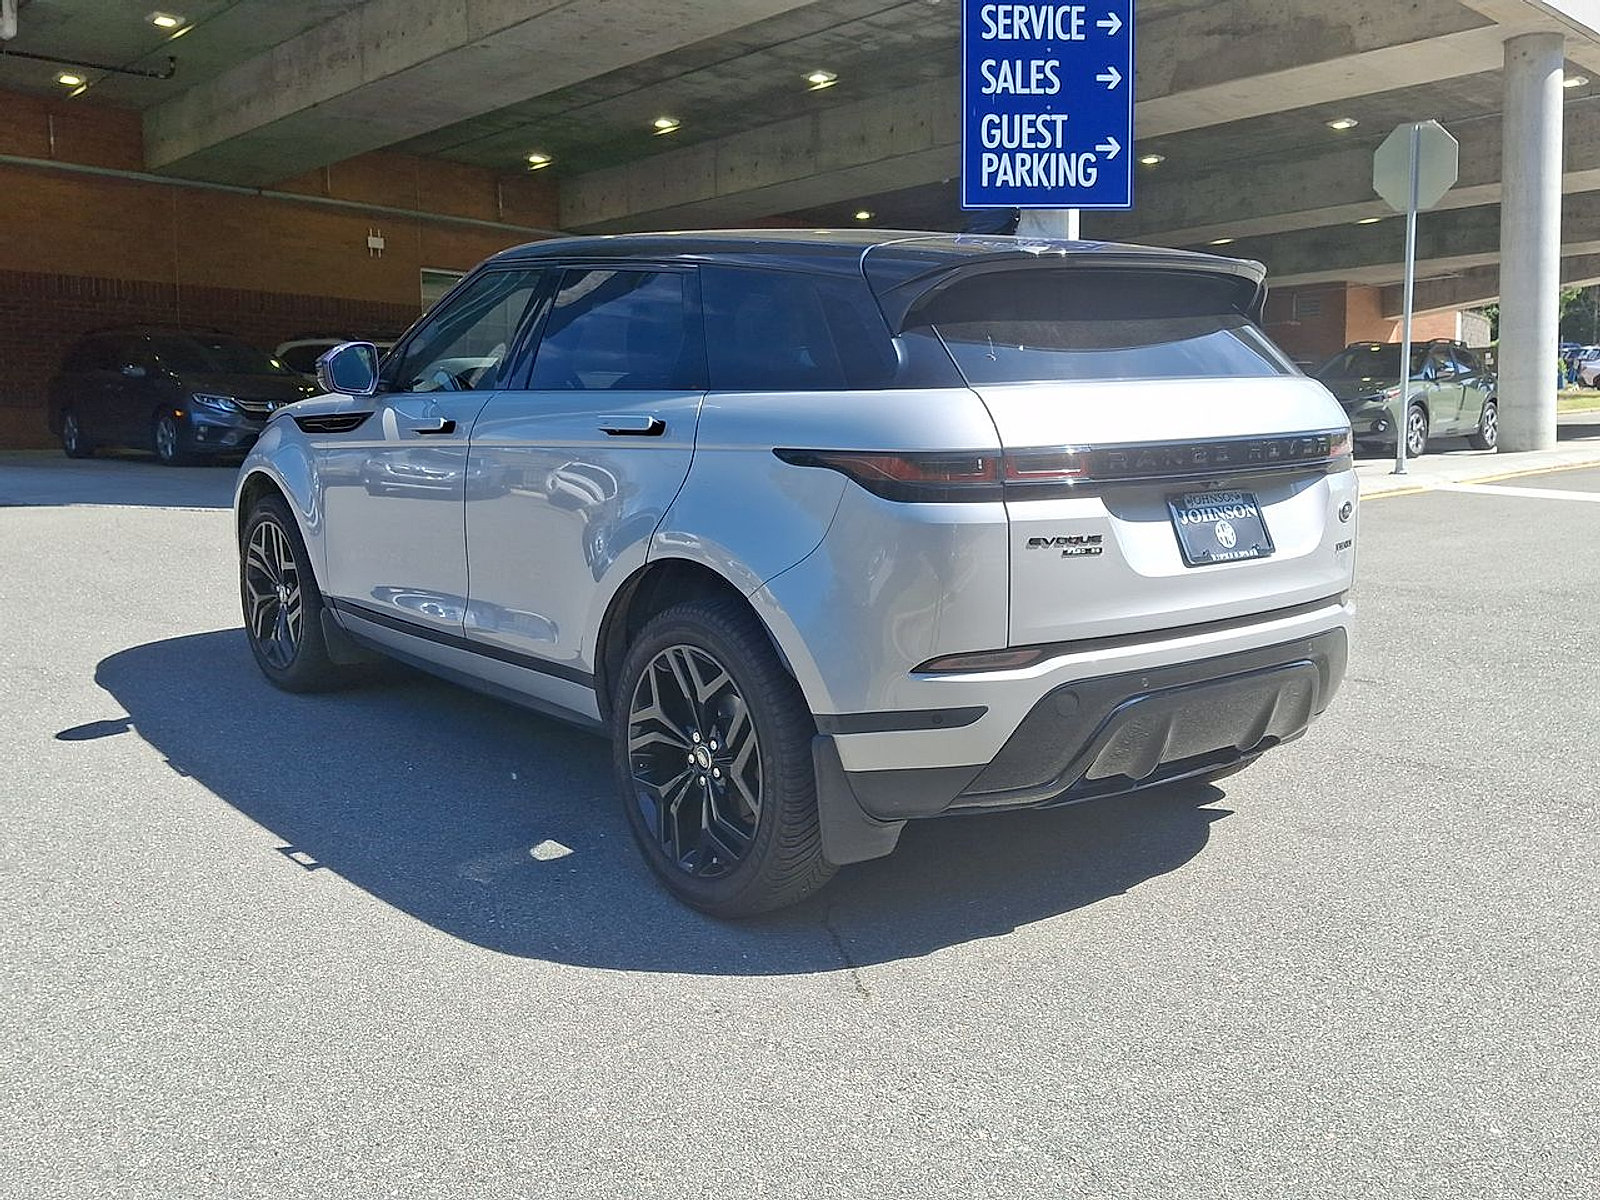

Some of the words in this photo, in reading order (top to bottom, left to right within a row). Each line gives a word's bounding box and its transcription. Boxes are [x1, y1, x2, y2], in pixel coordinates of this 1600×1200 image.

[981, 4, 1086, 40] SERVICE
[981, 59, 1061, 95] SALES
[981, 113, 1068, 149] GUEST
[981, 152, 1098, 187] PARKING
[1108, 446, 1230, 469] RANGE
[1180, 503, 1258, 525] JOHNSON
[1027, 534, 1103, 547] EVOQUE
